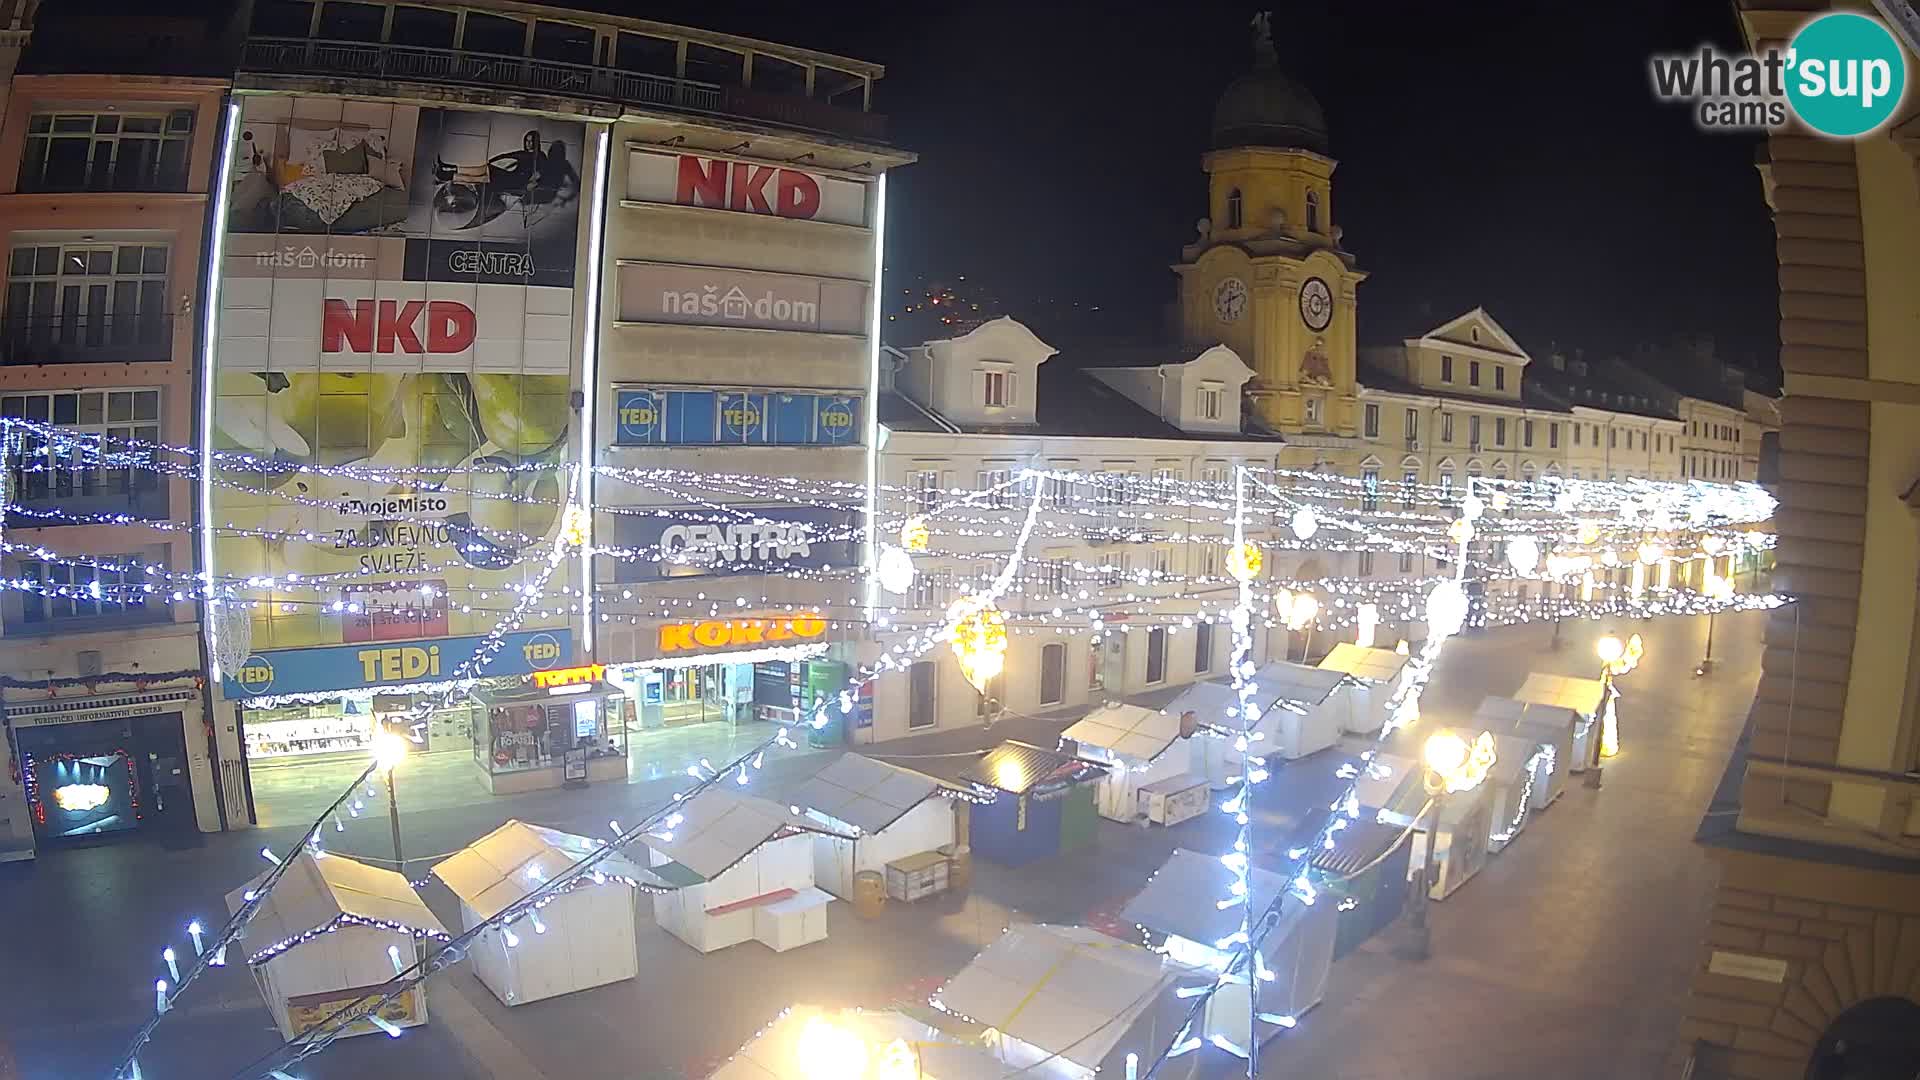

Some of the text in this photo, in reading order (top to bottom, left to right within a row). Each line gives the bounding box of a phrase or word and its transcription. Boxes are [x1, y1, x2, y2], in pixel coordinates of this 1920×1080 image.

[676, 155, 821, 219] NKD
[256, 247, 367, 269] naš dom
[448, 250, 535, 276] CENTRA
[662, 285, 817, 322] naš dom
[321, 299, 478, 353] NKD
[620, 408, 658, 425] TEDi
[724, 410, 760, 426] TEDi
[340, 497, 446, 515] #TvojeMisto
[334, 525, 450, 549] ZA DNEVNO
[660, 523, 810, 562] CENTRA
[660, 613, 826, 651] KORZO
[359, 646, 440, 683] TEDi
[522, 643, 561, 661] TEDi
[237, 665, 274, 684] TEDi
